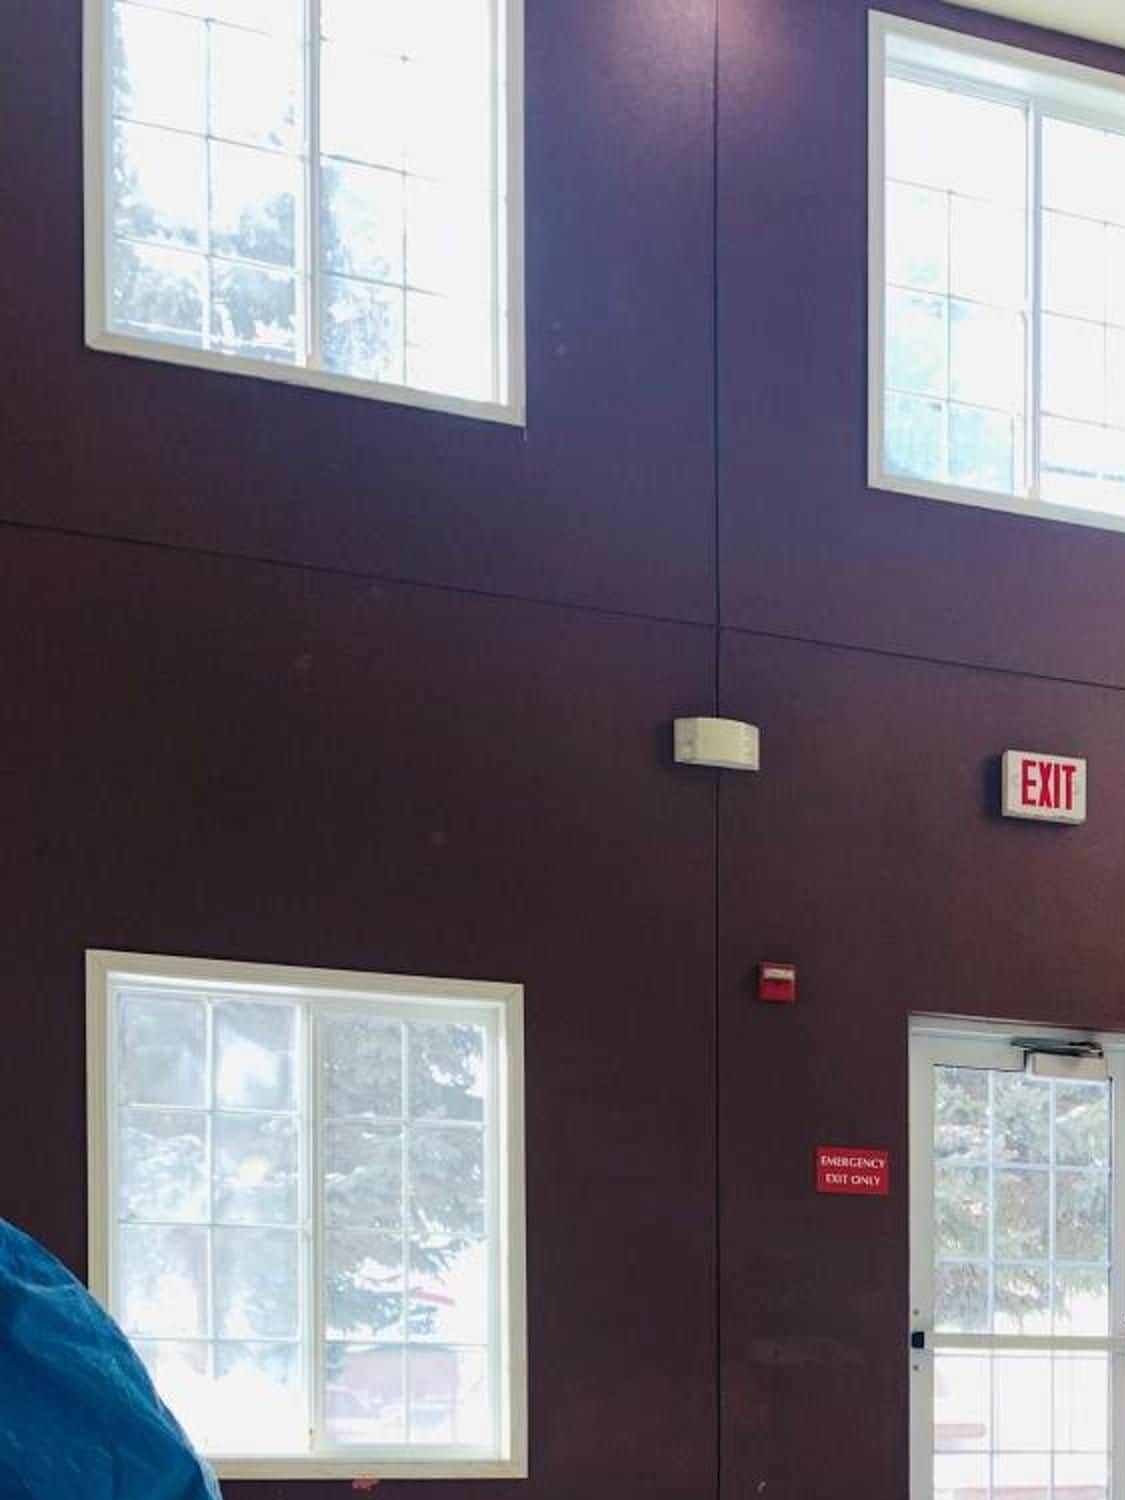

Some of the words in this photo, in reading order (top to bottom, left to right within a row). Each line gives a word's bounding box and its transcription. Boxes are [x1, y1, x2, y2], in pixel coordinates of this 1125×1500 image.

[1021, 759, 1076, 810] EXIT
[820, 1155, 885, 1169] EMERGENCY
[824, 1173, 848, 1185] EXIT
[850, 1174, 881, 1186] ONLY
